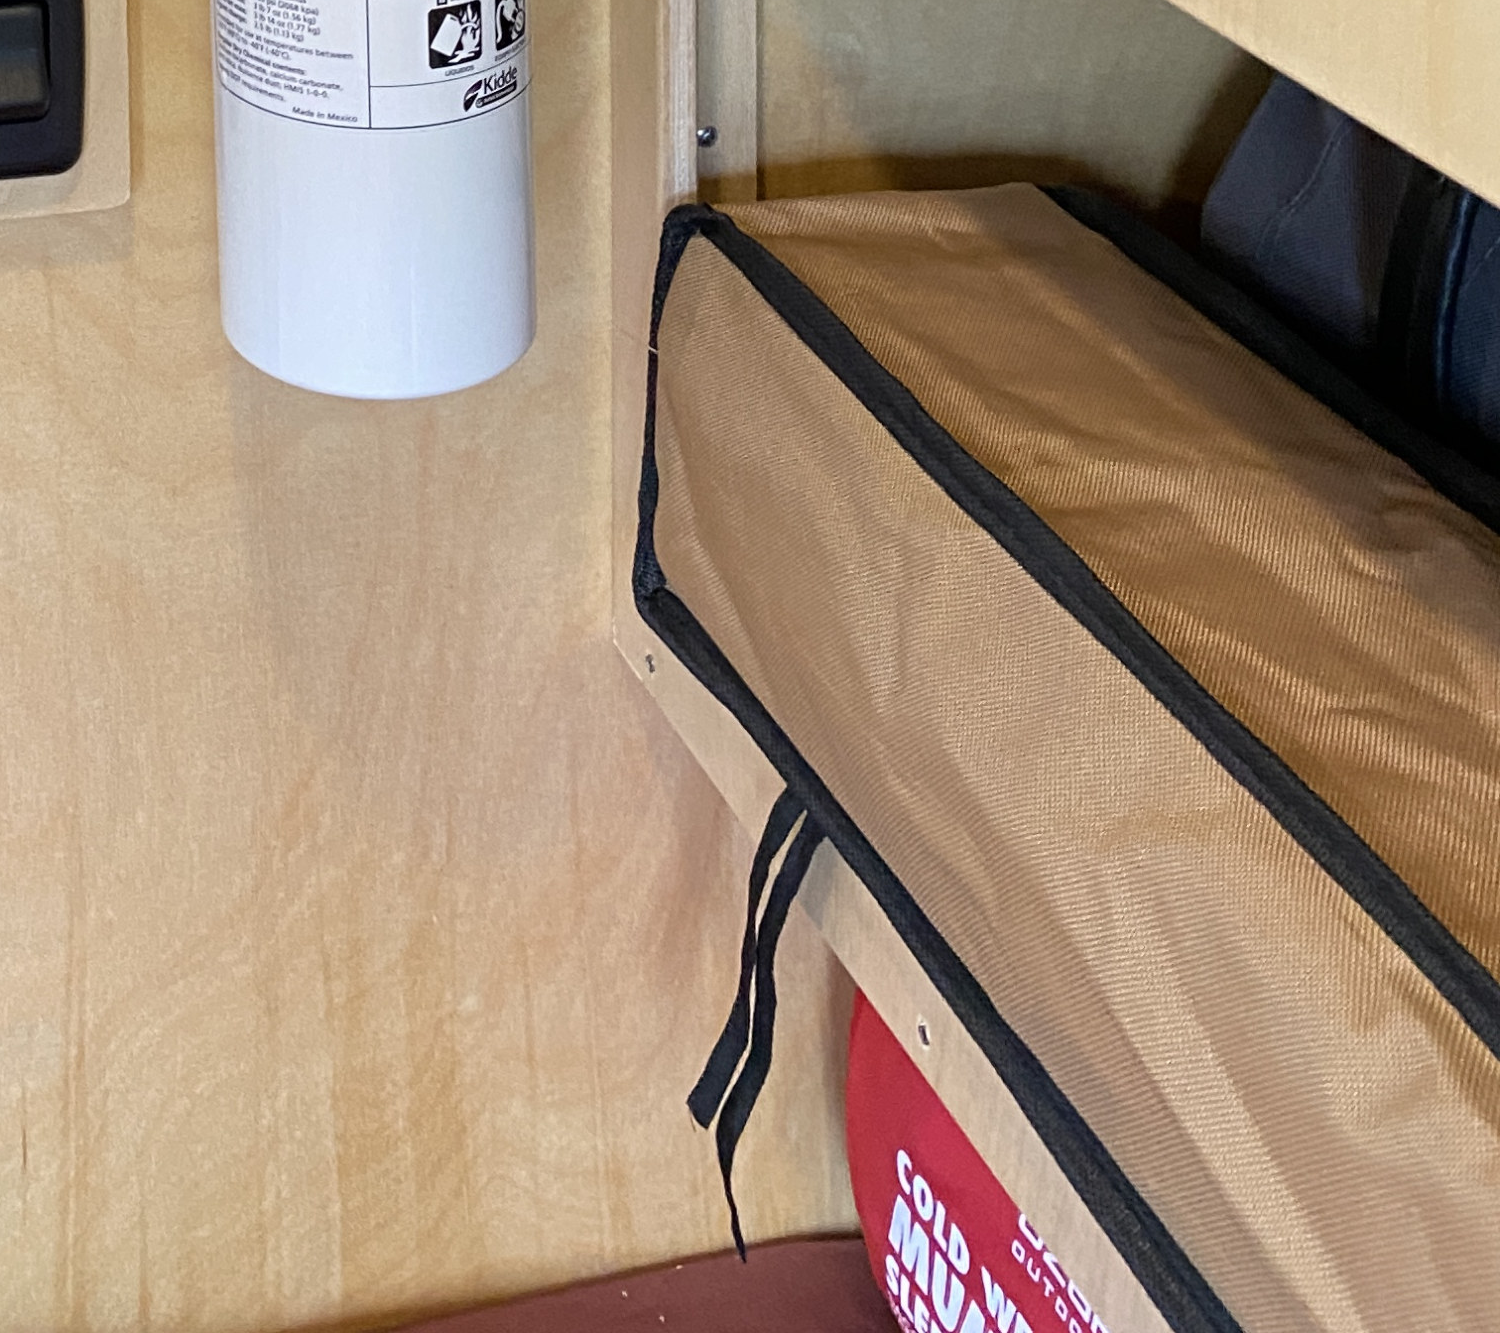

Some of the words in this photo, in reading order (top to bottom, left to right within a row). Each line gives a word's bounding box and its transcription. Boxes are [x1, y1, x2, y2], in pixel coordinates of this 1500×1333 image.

[484, 65, 518, 94] Kidde
[292, 105, 314, 117] Made
[316, 110, 324, 119] in
[326, 112, 357, 122] Mexico
[897, 1149, 970, 1275] COLD
